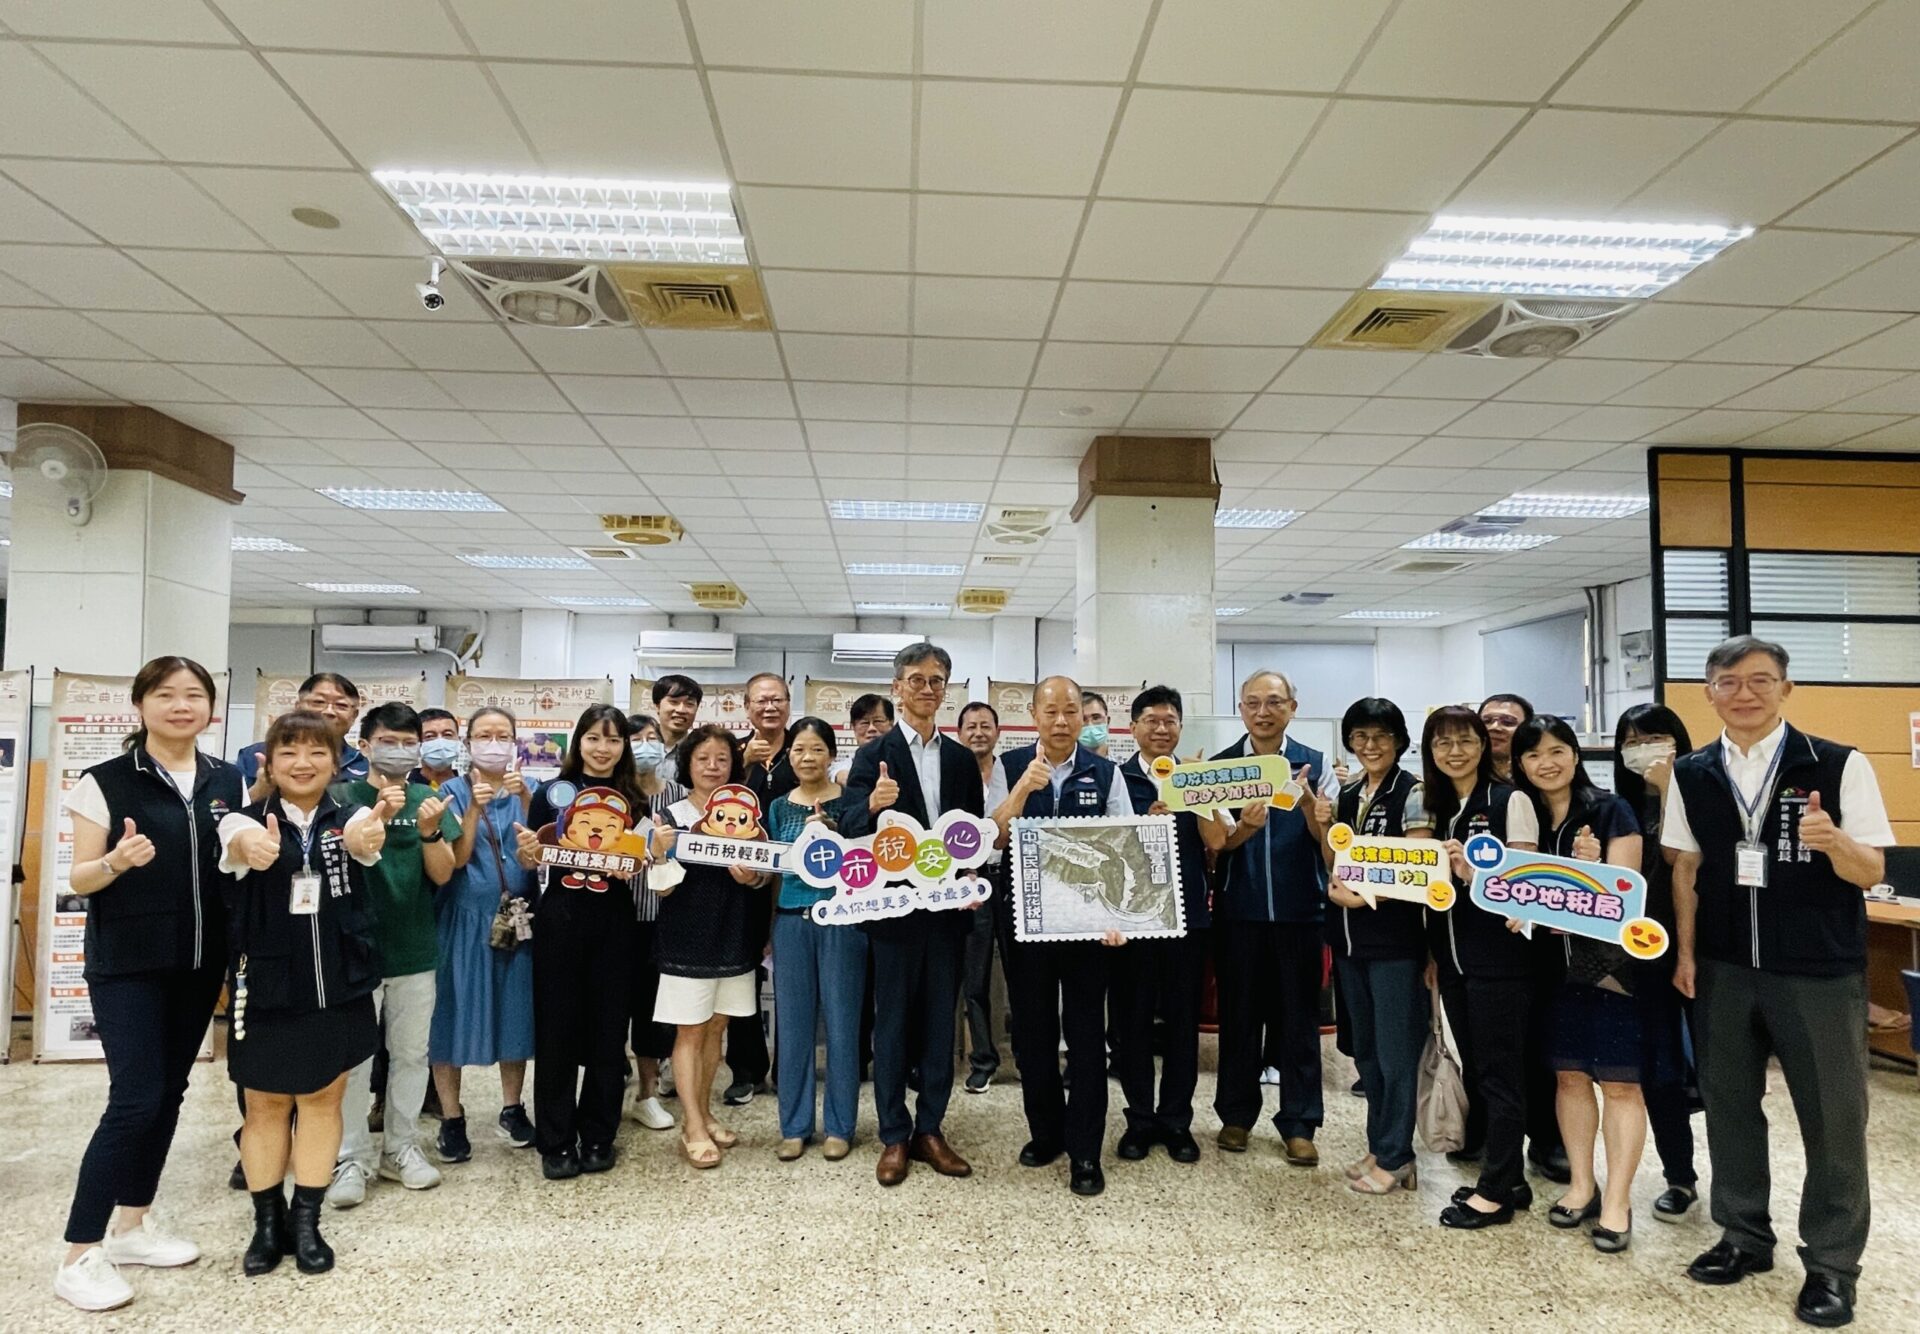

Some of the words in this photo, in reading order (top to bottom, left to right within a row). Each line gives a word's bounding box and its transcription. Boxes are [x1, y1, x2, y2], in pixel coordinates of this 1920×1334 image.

[541, 847, 635, 872] 開放檔案應用
[688, 842, 770, 862] 中市稅輕鬆
[1021, 830, 1042, 933] 中華民國印花稅票
[1483, 876, 1625, 922] 台中地稅局
